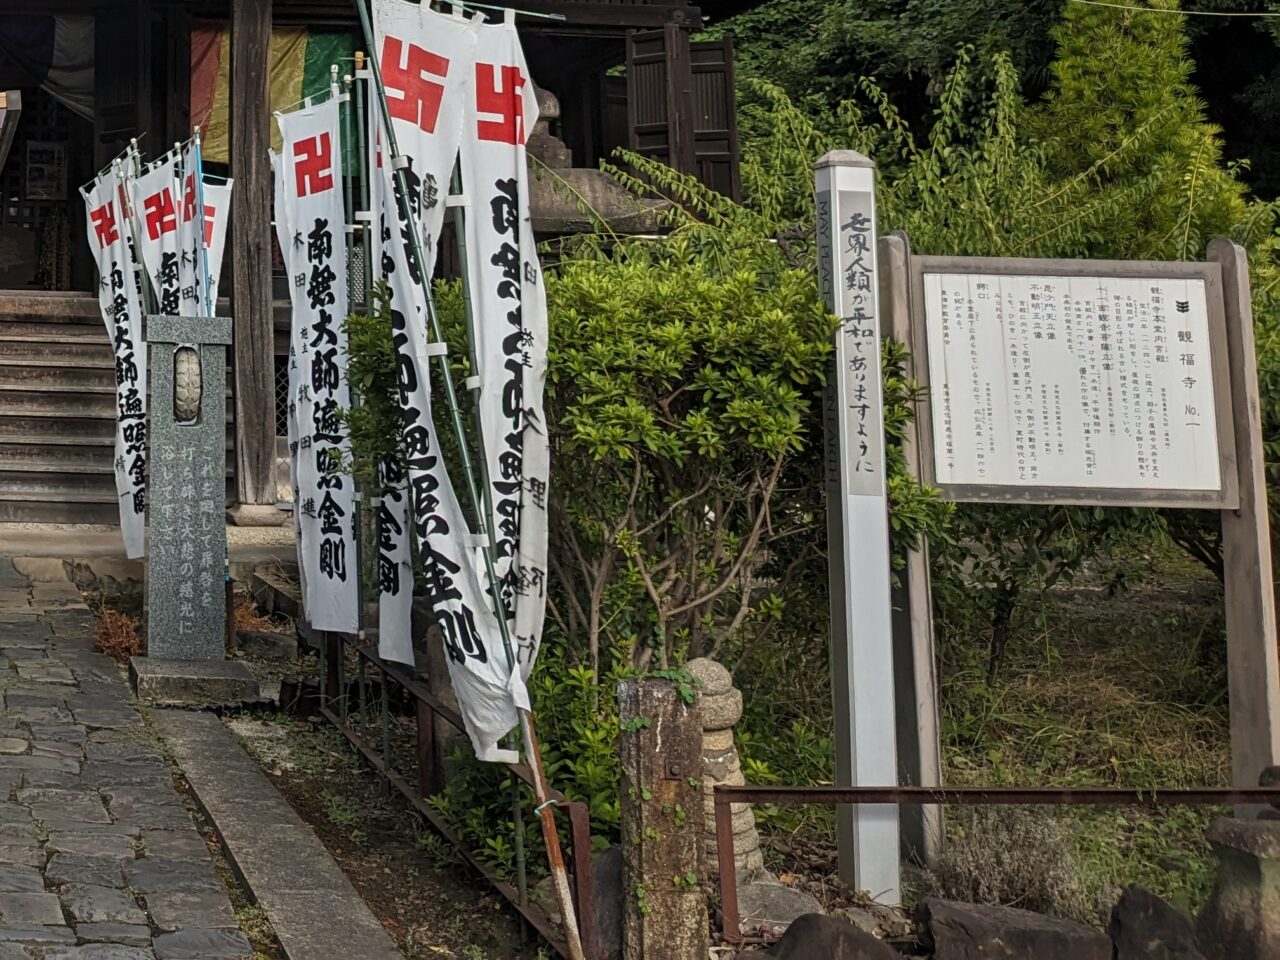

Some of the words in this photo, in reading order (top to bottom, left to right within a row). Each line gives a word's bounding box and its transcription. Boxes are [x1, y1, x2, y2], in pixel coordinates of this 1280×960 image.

[819, 201, 830, 239] MAY
[1030, 284, 1044, 340] 不動明王立像
[840, 212, 875, 473] 世界人類が平和でありますように
[1177, 330, 1197, 390] 観福寺
[307, 217, 348, 583] 南無大師遍照金剛
